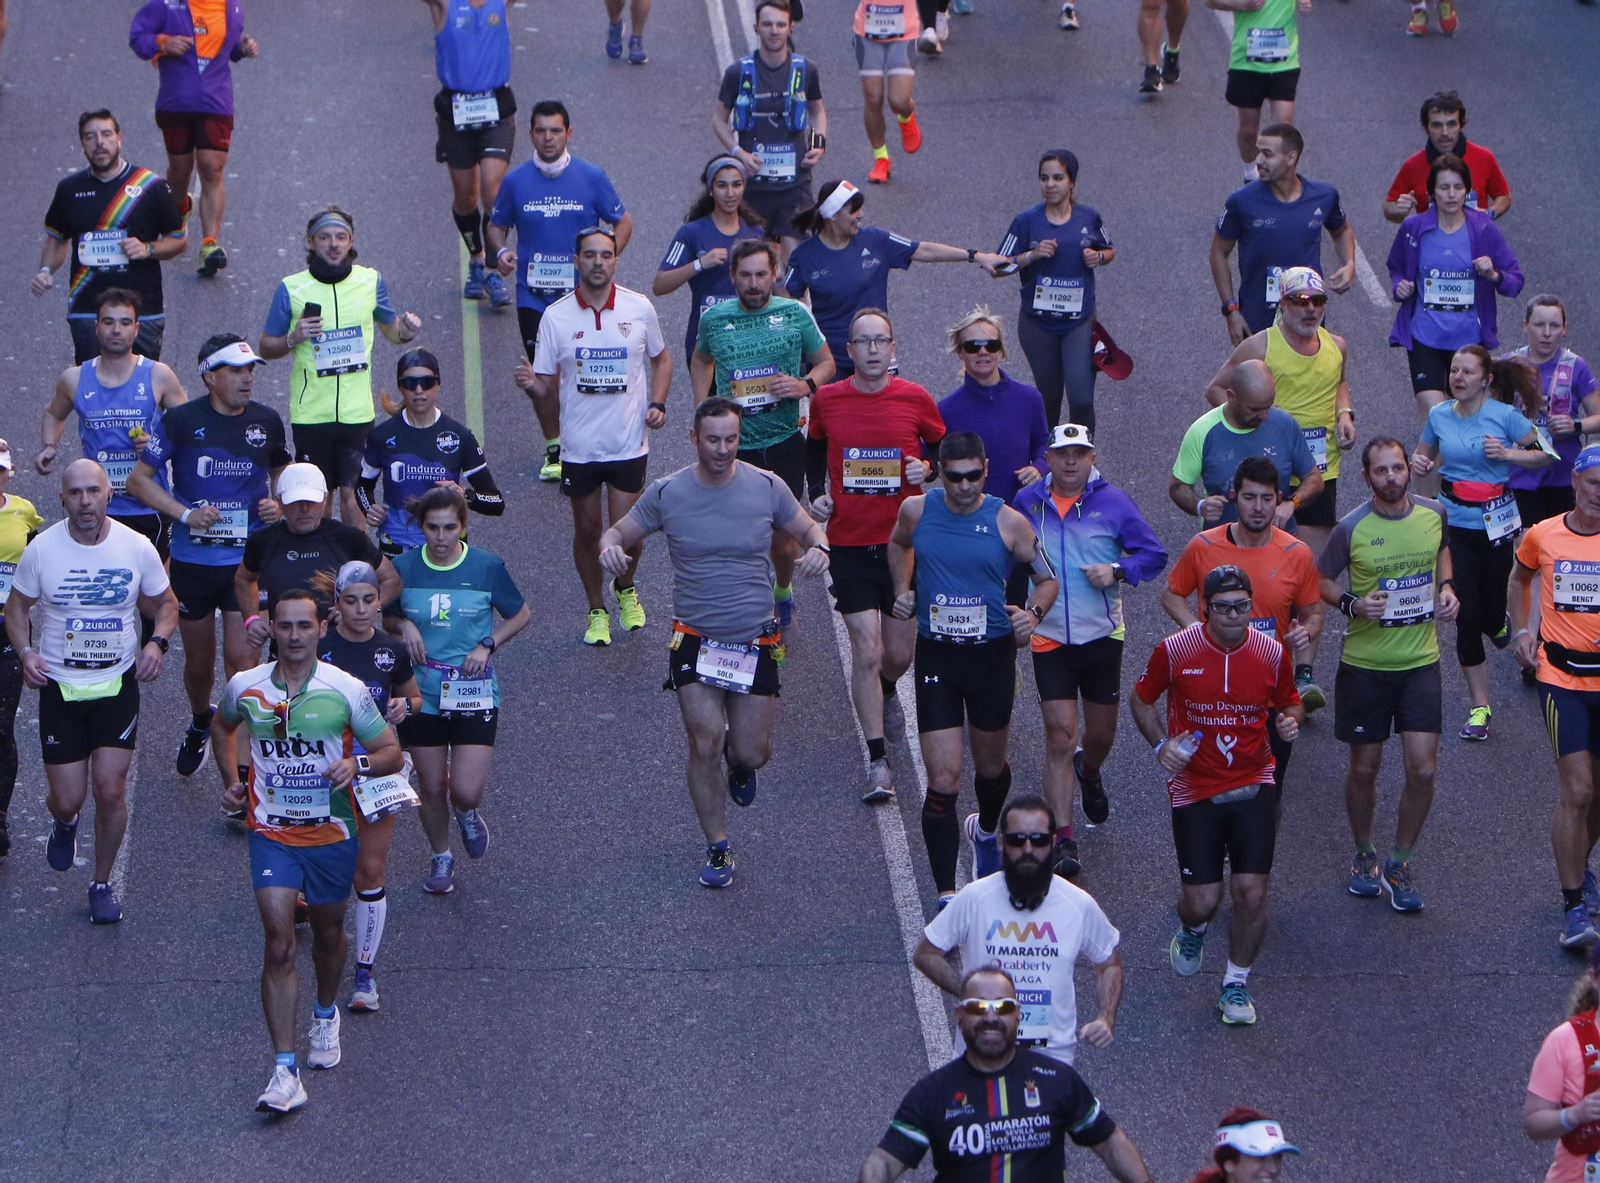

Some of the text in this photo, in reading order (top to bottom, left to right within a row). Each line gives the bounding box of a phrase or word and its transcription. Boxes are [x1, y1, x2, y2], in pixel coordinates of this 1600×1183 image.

[765, 144, 791, 152] ZURICH
[75, 190, 96, 198] KELME
[523, 203, 550, 212] Chicago
[544, 210, 562, 218] 2017
[94, 232, 122, 240] ZURICH
[1441, 270, 1469, 278] ZURICH
[1052, 278, 1080, 287] ZURICH
[1048, 294, 1072, 302] 11292
[735, 322, 754, 332] RUN
[754, 320, 765, 328] AS
[328, 329, 356, 340] ZURICH
[327, 344, 352, 355] 12580
[736, 351, 756, 360] RUN
[756, 348, 768, 357] AS
[769, 344, 787, 354] ONE
[331, 358, 351, 366] JULIEN
[589, 365, 614, 374] 12715
[744, 368, 774, 378] ZURICH
[580, 376, 598, 384] MARÍA
[746, 384, 767, 395] 5503
[748, 396, 766, 404] CHRIS
[861, 450, 894, 458] ZURICH
[214, 458, 253, 470] indurco
[107, 467, 132, 476] 11810
[406, 464, 446, 474] indurco
[861, 467, 884, 476] 5565
[210, 501, 242, 510] ZURICH
[204, 529, 233, 537] JUANFRA
[1371, 537, 1385, 547] edp
[1376, 559, 1433, 574] DE SEVILLA
[1574, 564, 1600, 572] ZURIC
[1399, 576, 1428, 588] ZURICH
[1570, 582, 1599, 592] 10062
[949, 596, 982, 605] ZURICH
[1399, 596, 1421, 606] 9606
[1393, 606, 1424, 617] MARTÍNEZ
[948, 614, 970, 624] 9431
[86, 621, 118, 630] ZURICH
[938, 625, 980, 634] EL SEVILLANO
[84, 640, 108, 648] 9739
[72, 651, 88, 659] KING
[717, 657, 740, 670] 7649
[716, 669, 734, 679] SOLO
[456, 687, 481, 696] 12981
[456, 701, 482, 709] ANDREA
[1185, 698, 1214, 712] Grupo
[1186, 711, 1238, 726] Santander
[276, 762, 316, 776] Ceuta
[286, 779, 321, 787] ZURICH
[371, 780, 399, 794] 12983
[282, 795, 313, 804] 12029
[374, 791, 408, 809] ESTEFANÍA
[985, 944, 1060, 958] VI MARATÓN
[948, 1113, 1051, 1156] 40 MARATÓN
[1005, 1128, 1035, 1137] SEVILLA
[992, 1131, 1052, 1145] LOS PALACIOS
[1000, 1140, 1051, 1152] VILLAFRANCA
